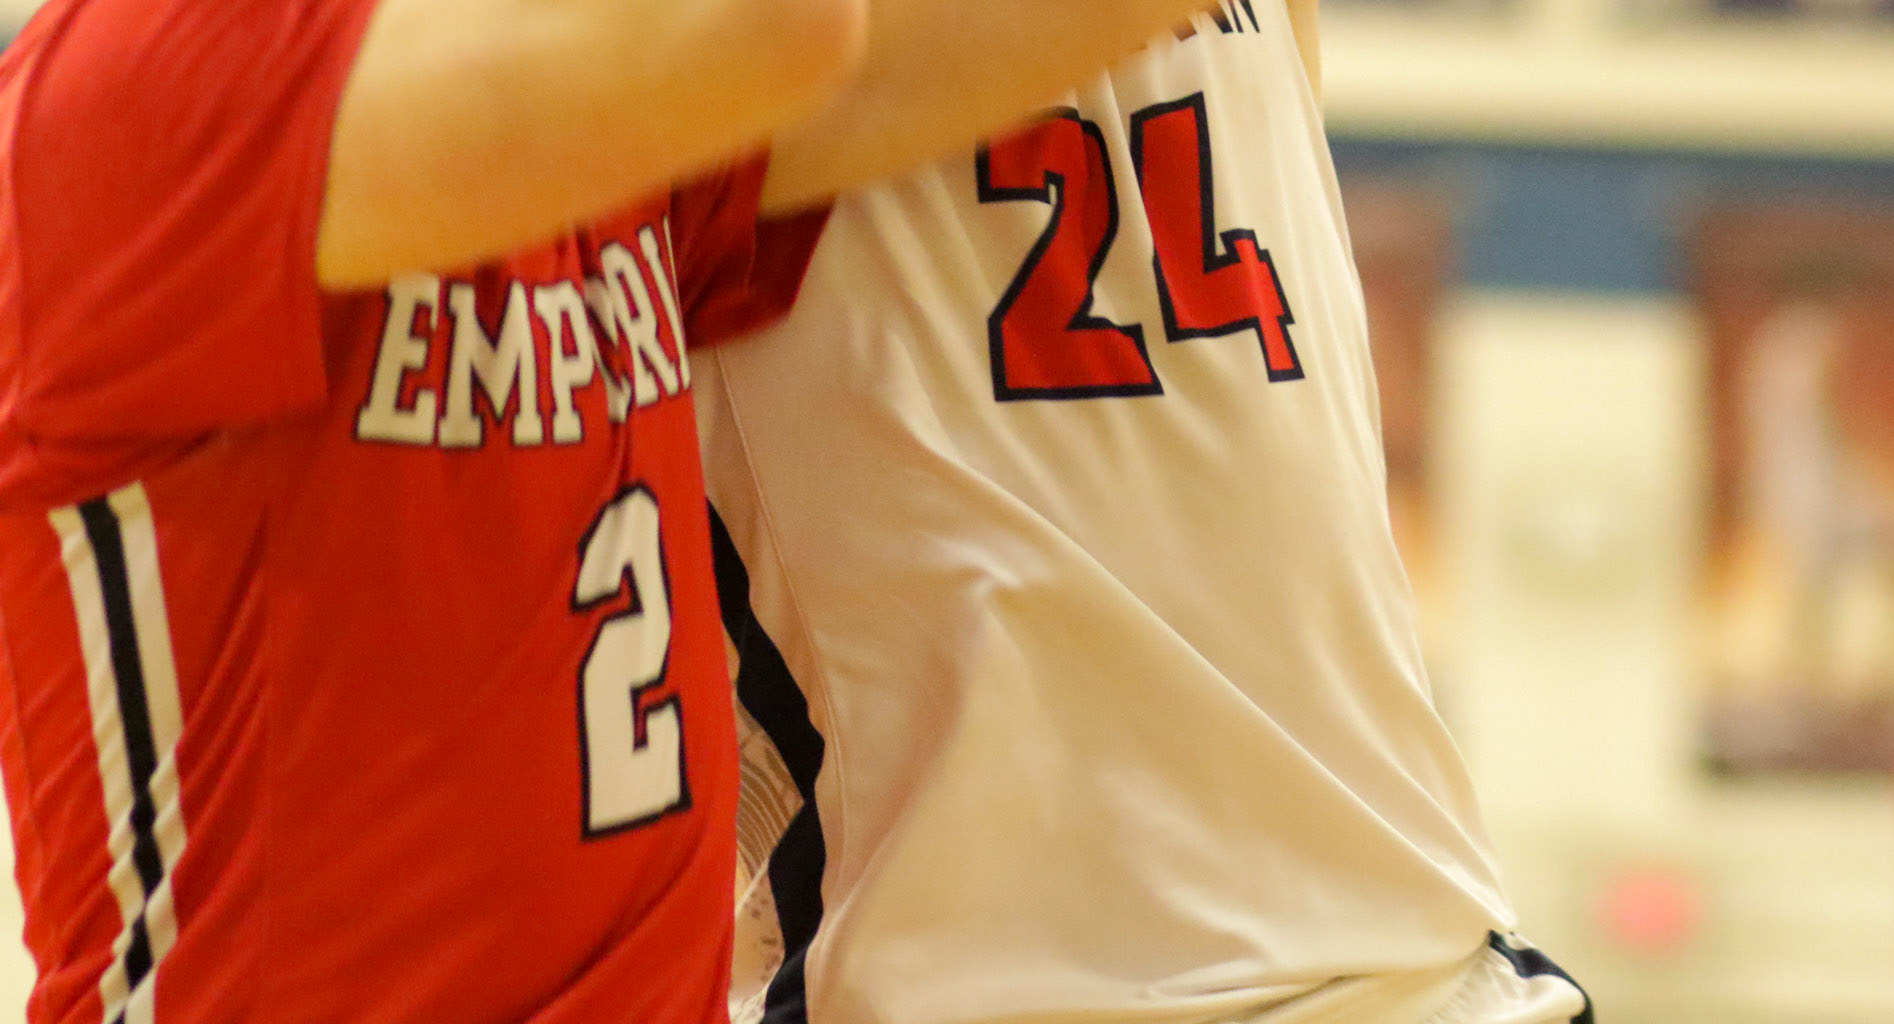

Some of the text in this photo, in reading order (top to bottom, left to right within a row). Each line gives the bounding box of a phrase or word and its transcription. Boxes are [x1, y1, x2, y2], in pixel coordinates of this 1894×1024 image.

[353, 214, 691, 449] EMPORI
[974, 91, 1306, 403] 24
[569, 481, 692, 842] 2
